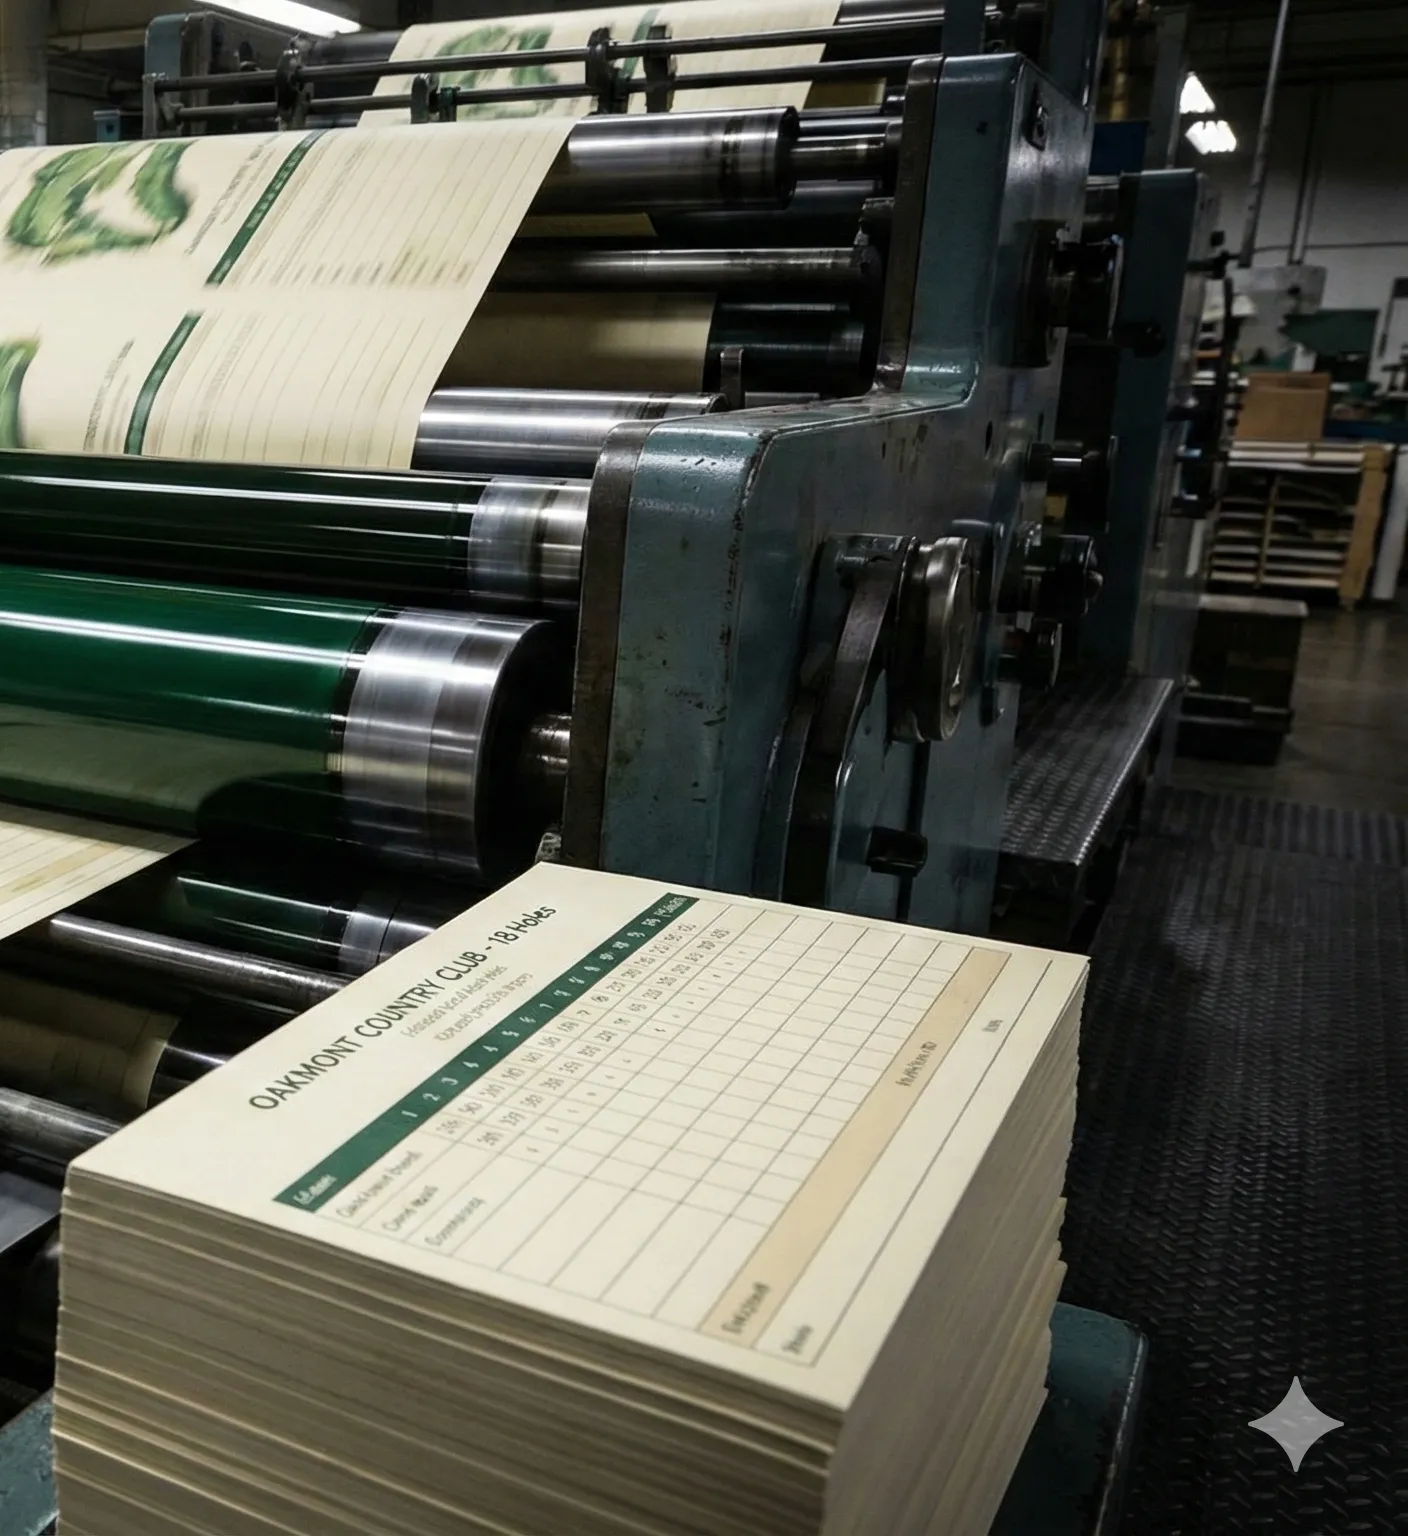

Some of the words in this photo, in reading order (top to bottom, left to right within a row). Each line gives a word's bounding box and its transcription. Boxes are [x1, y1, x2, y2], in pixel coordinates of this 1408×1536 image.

[248, 1035, 364, 1110] OAKMONT
[353, 978, 446, 1038] COUNTRY
[435, 950, 488, 982] CLUB
[488, 930, 520, 945] 18
[504, 906, 557, 934] Holes
